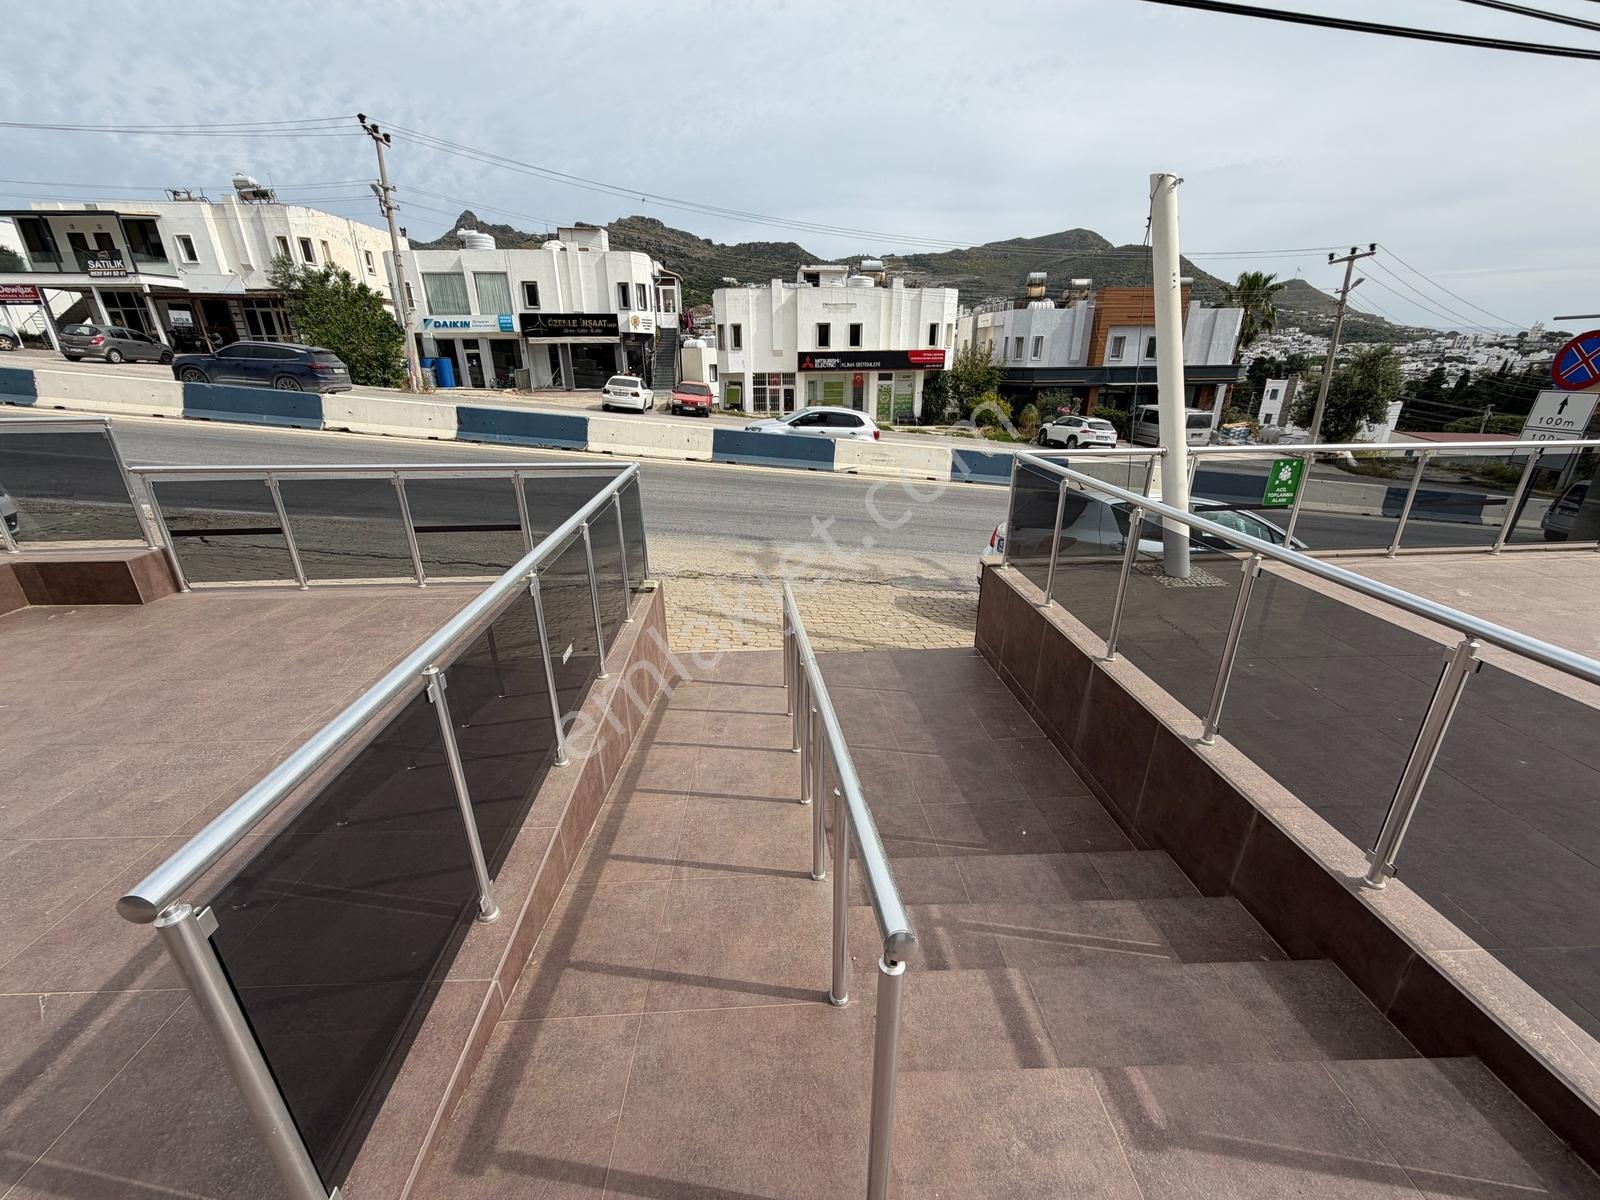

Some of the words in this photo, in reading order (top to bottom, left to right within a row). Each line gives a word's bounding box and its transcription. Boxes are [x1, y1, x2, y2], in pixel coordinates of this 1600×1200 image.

[87, 260, 125, 269] SATILIK
[434, 321, 471, 329] DAIKIN
[547, 318, 578, 328] ÖZENLE
[580, 317, 608, 329] İNŞAAT
[1538, 416, 1574, 427] 100m
